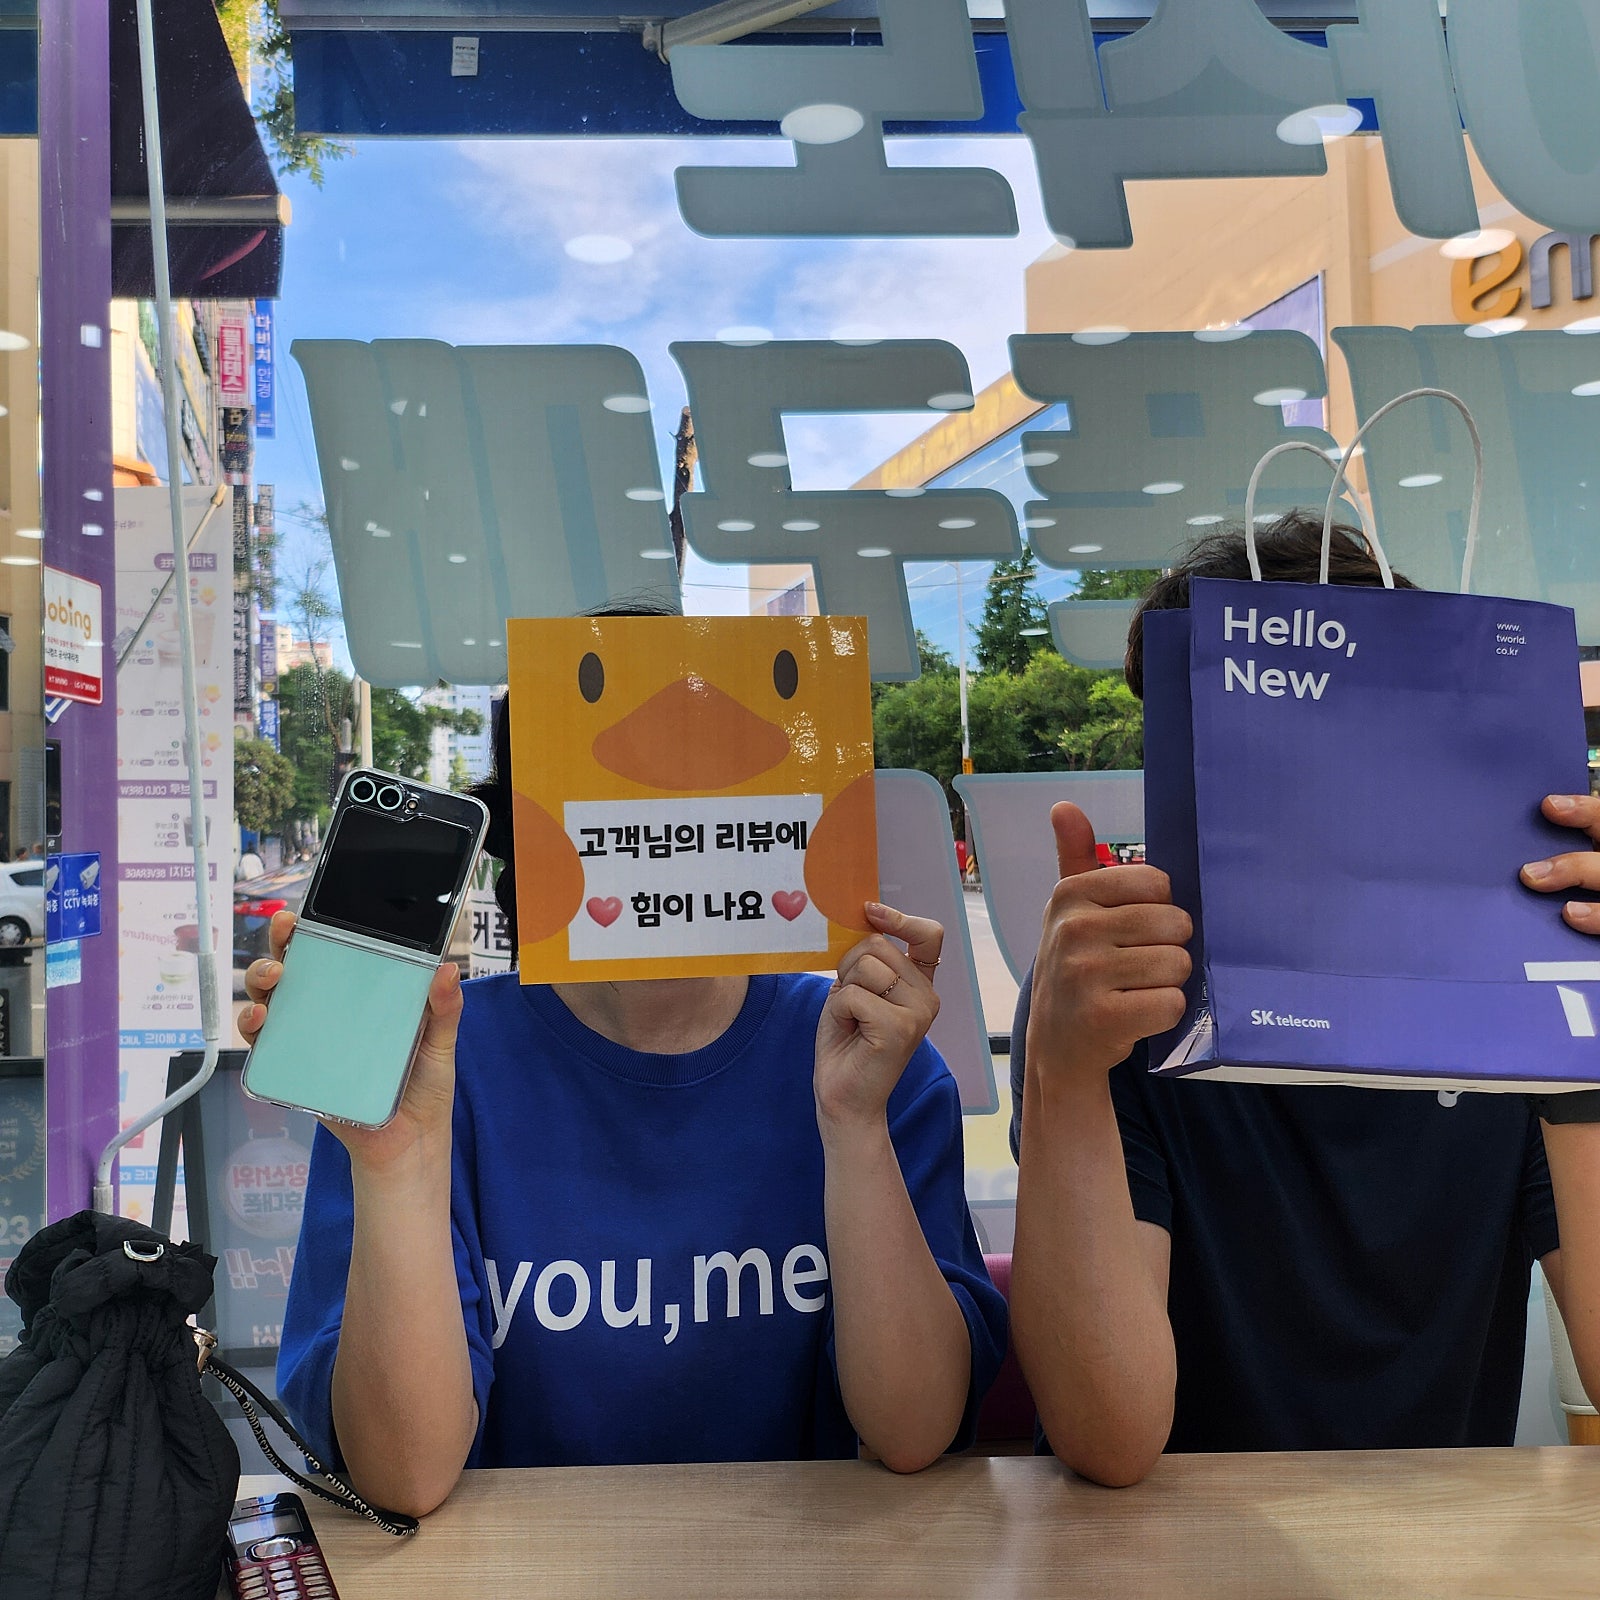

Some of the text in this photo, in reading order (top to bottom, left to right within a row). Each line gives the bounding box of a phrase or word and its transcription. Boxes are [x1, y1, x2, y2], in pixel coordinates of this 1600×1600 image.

[256, 315, 271, 363] 다비치
[257, 367, 271, 398] 안경
[1224, 606, 1357, 658] Hello,
[1496, 623, 1521, 632] www.
[1496, 634, 1527, 645] tworld.
[1496, 647, 1519, 656] co.kr
[1224, 657, 1330, 701] New
[578, 821, 807, 859] 고객님의 리뷰에
[64, 894, 99, 909] CCTV 녹화중
[631, 890, 765, 927] 힘이 나요
[1250, 1009, 1330, 1029] SK telecom
[484, 1244, 829, 1349] you,me
